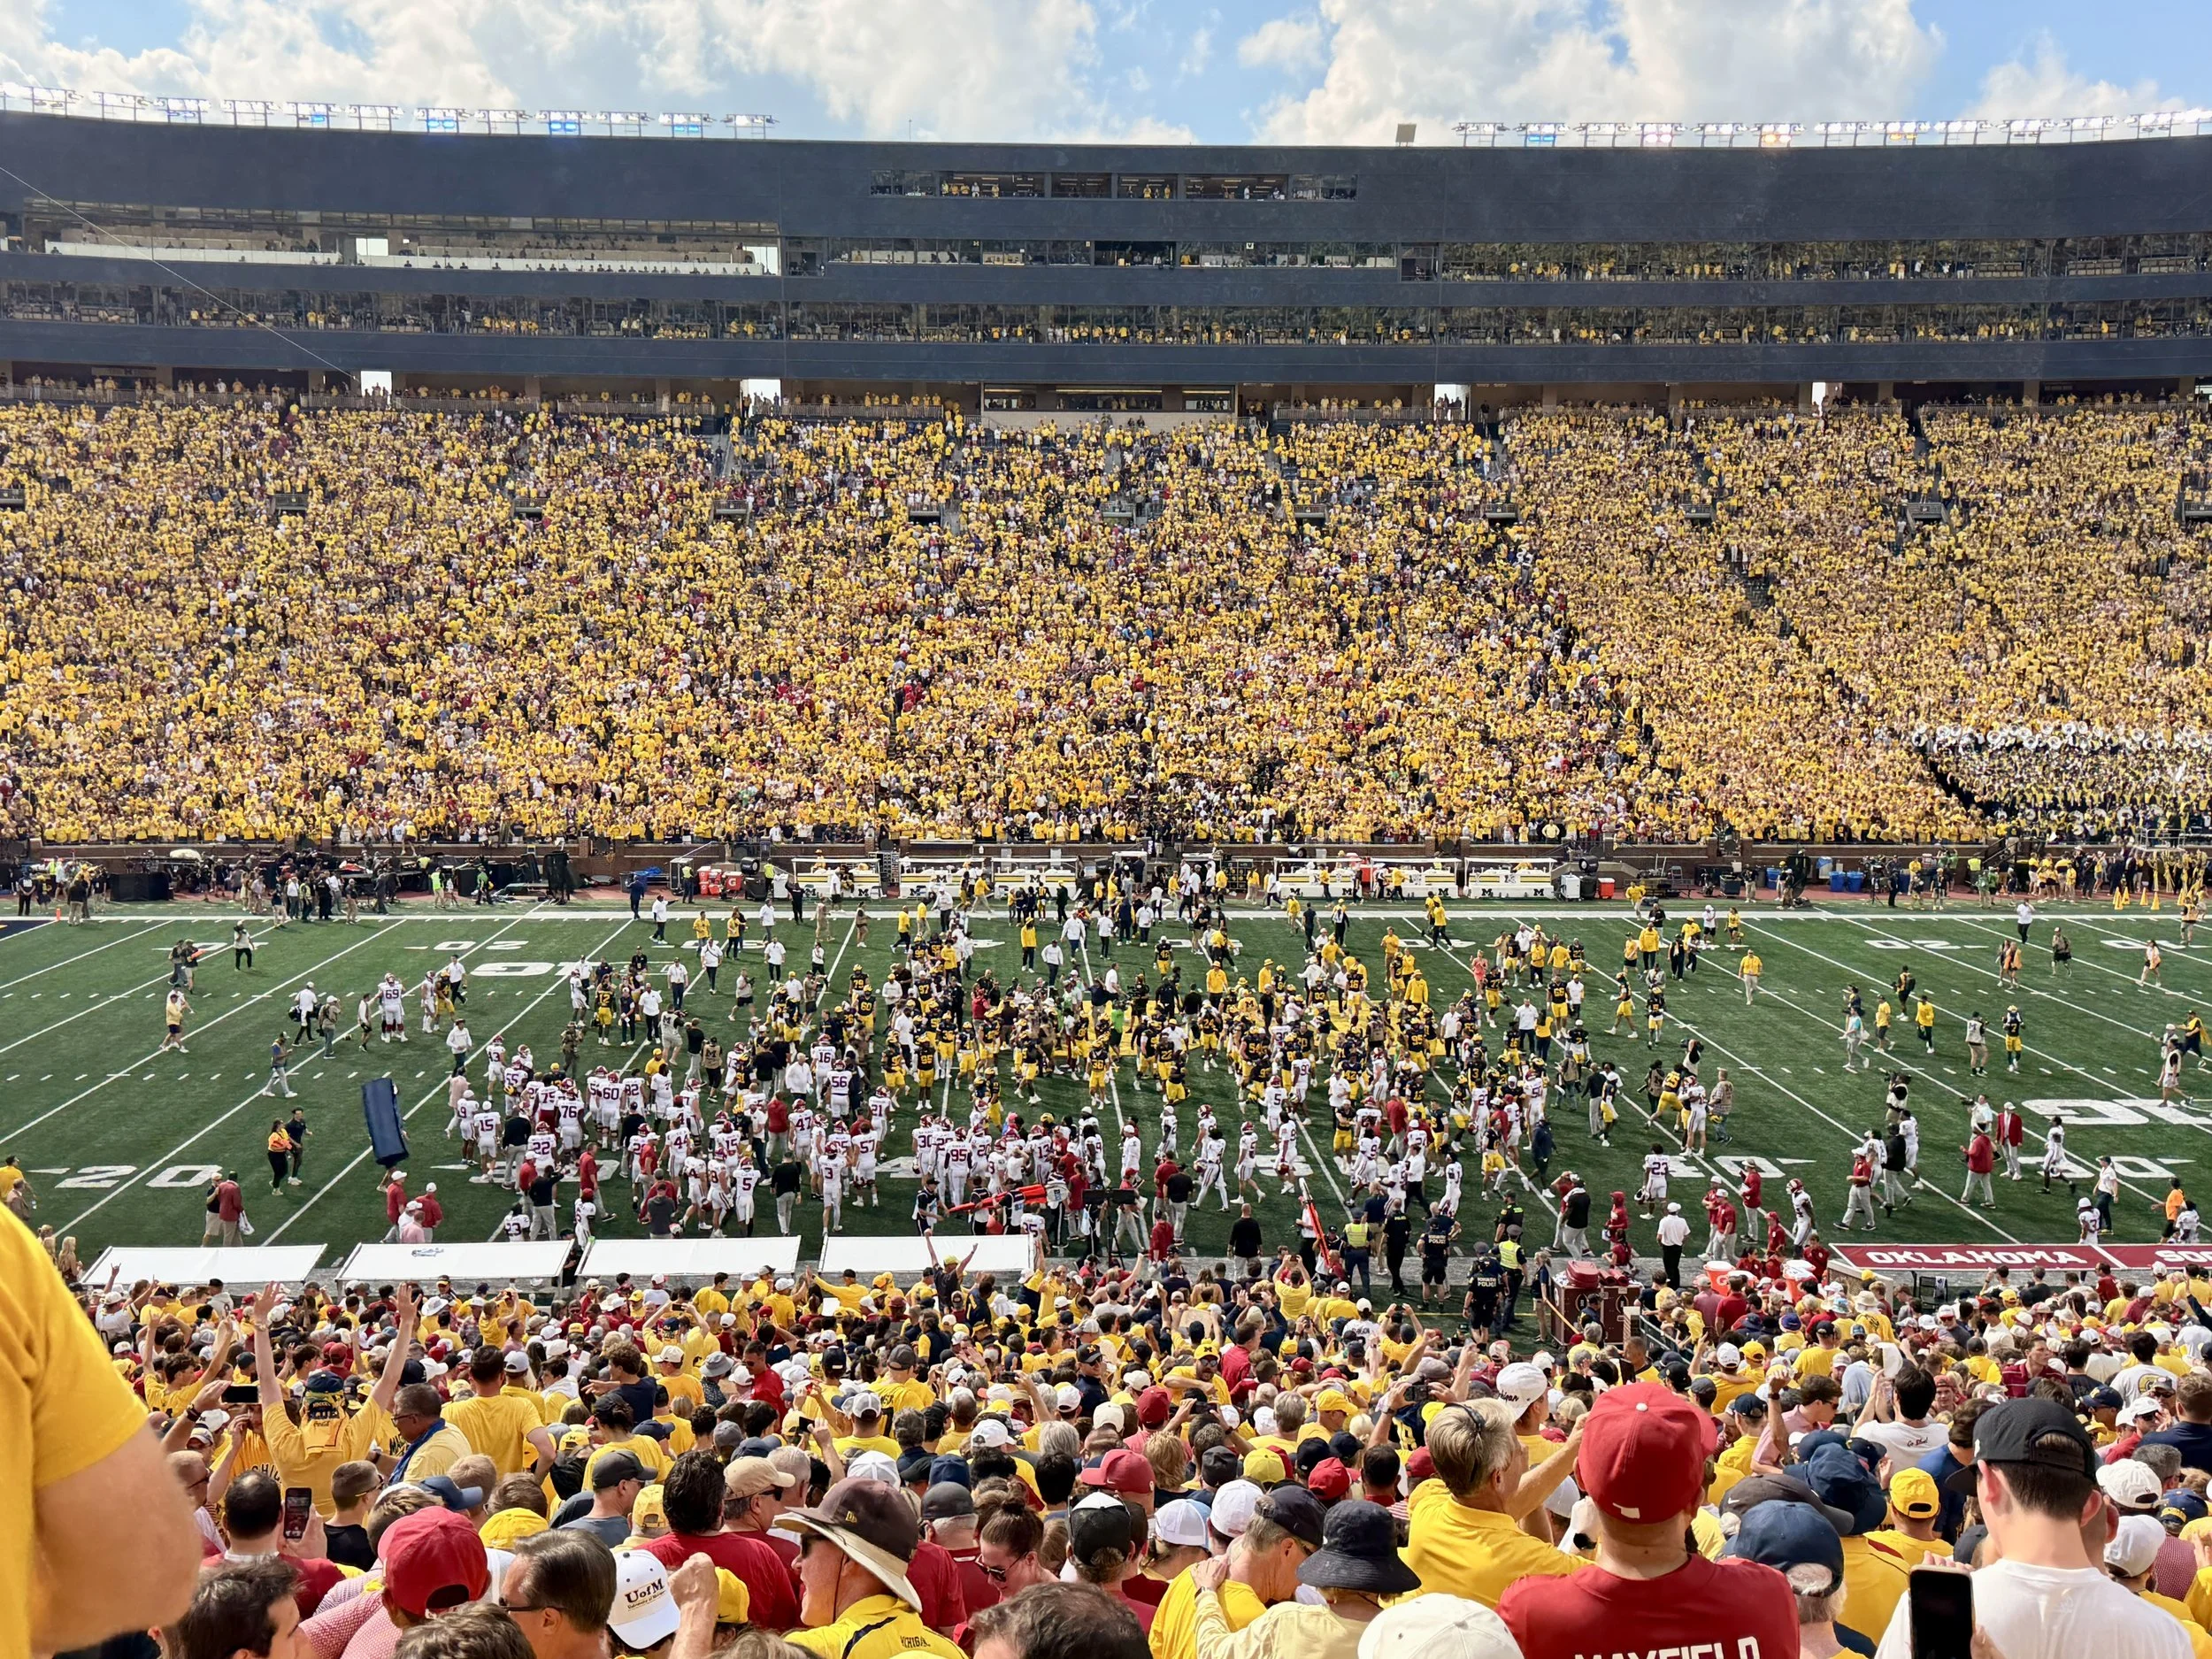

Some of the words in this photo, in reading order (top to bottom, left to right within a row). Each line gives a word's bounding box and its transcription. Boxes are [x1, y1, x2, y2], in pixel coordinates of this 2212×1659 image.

[1030, 874, 1041, 883] M
[1289, 887, 1301, 896] M
[1438, 887, 1449, 896] M
[1481, 887, 1492, 896] M
[1533, 887, 1544, 896] M
[385, 988, 399, 999] 69
[599, 993, 611, 1003] 12
[706, 1049, 716, 1058] M
[819, 1051, 832, 1064] 16
[832, 1076, 847, 1088] 56
[603, 1087, 619, 1100] 60
[1274, 1094, 1282, 1106] 5
[560, 1106, 577, 1118] 76
[479, 1118, 494, 1132] 15
[795, 1117, 811, 1131] 47
[533, 1141, 550, 1155] 22
[860, 1139, 875, 1154] 57
[951, 1149, 967, 1162] 95
[824, 1167, 833, 1179] 3
[1651, 1162, 1668, 1175] 23
[55, 1164, 224, 1188] 20
[742, 1178, 752, 1191] 5
[505, 1222, 522, 1236] 23
[1865, 1249, 2088, 1264] OKLAHOMA
[625, 1578, 664, 1603] UofM
